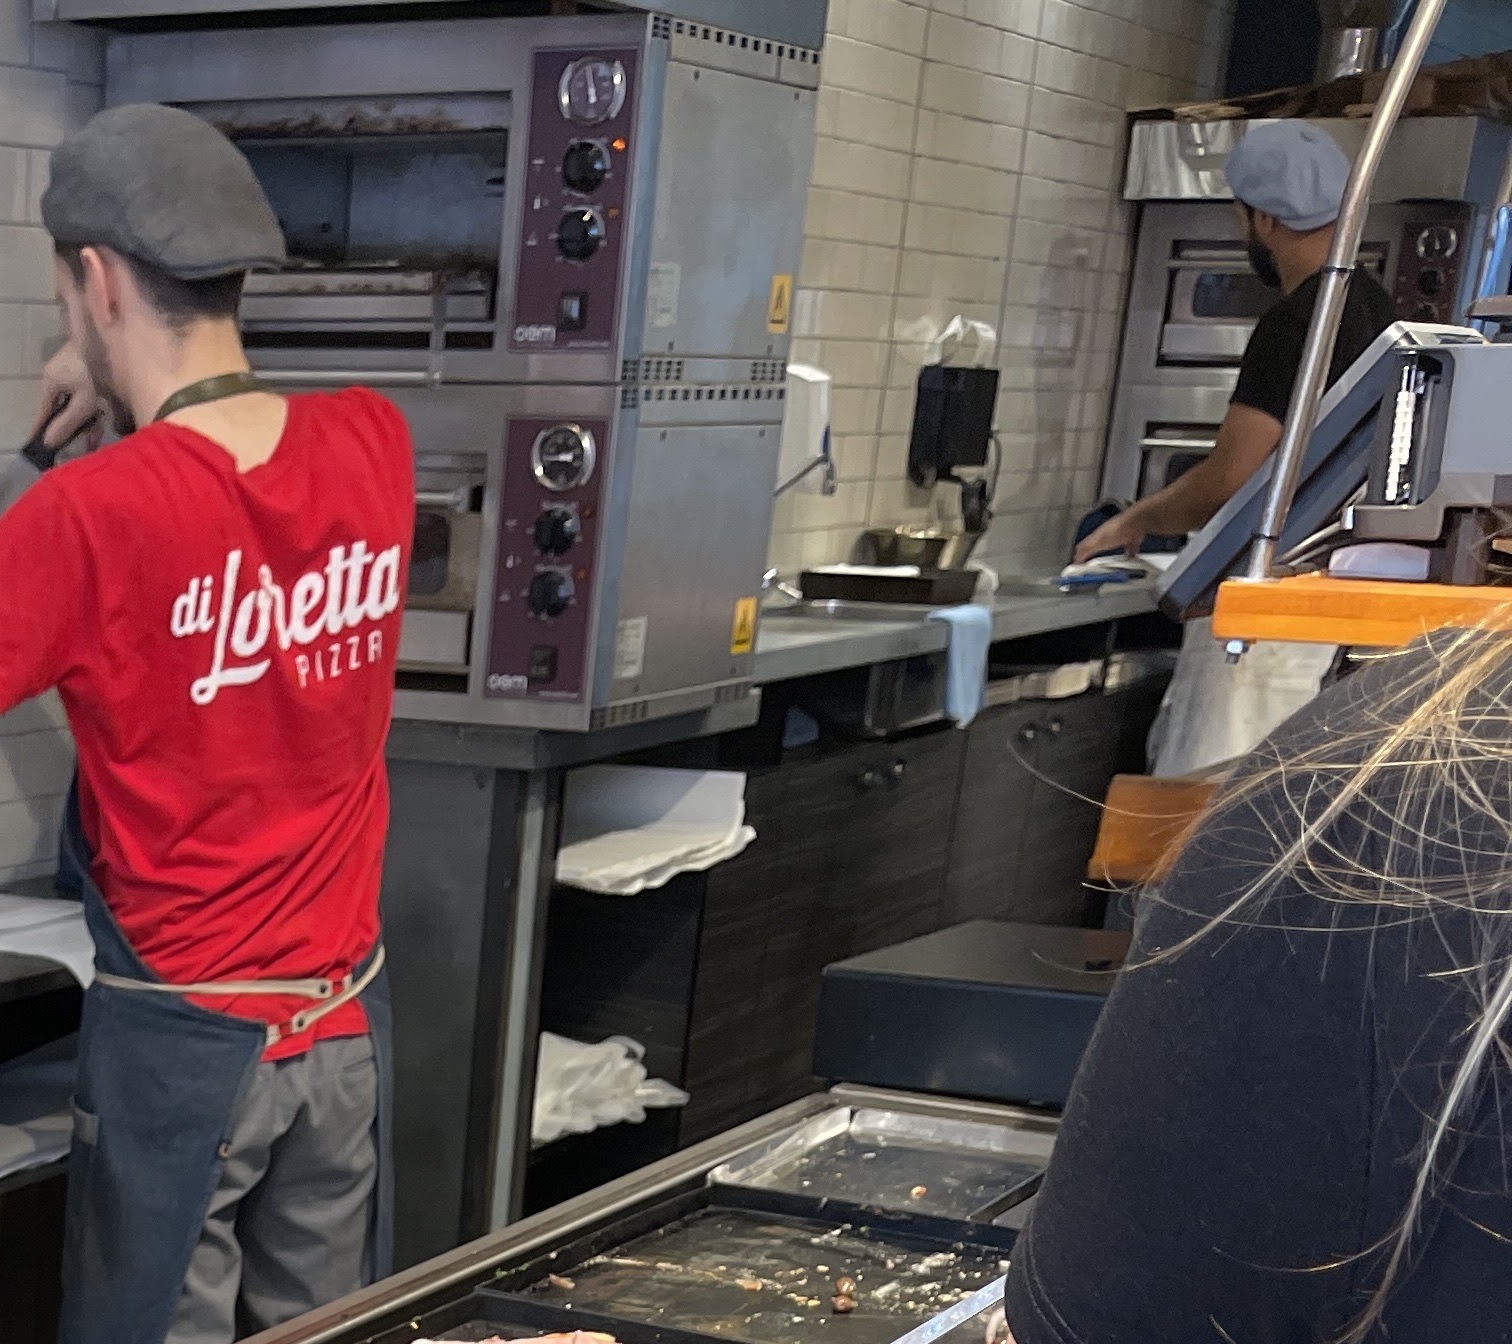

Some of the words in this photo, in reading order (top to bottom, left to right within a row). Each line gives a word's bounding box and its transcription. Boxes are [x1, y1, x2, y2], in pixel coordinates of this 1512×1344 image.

[170, 574, 215, 638] di
[190, 539, 402, 706] Loretta
[295, 629, 384, 689] PIZZA
